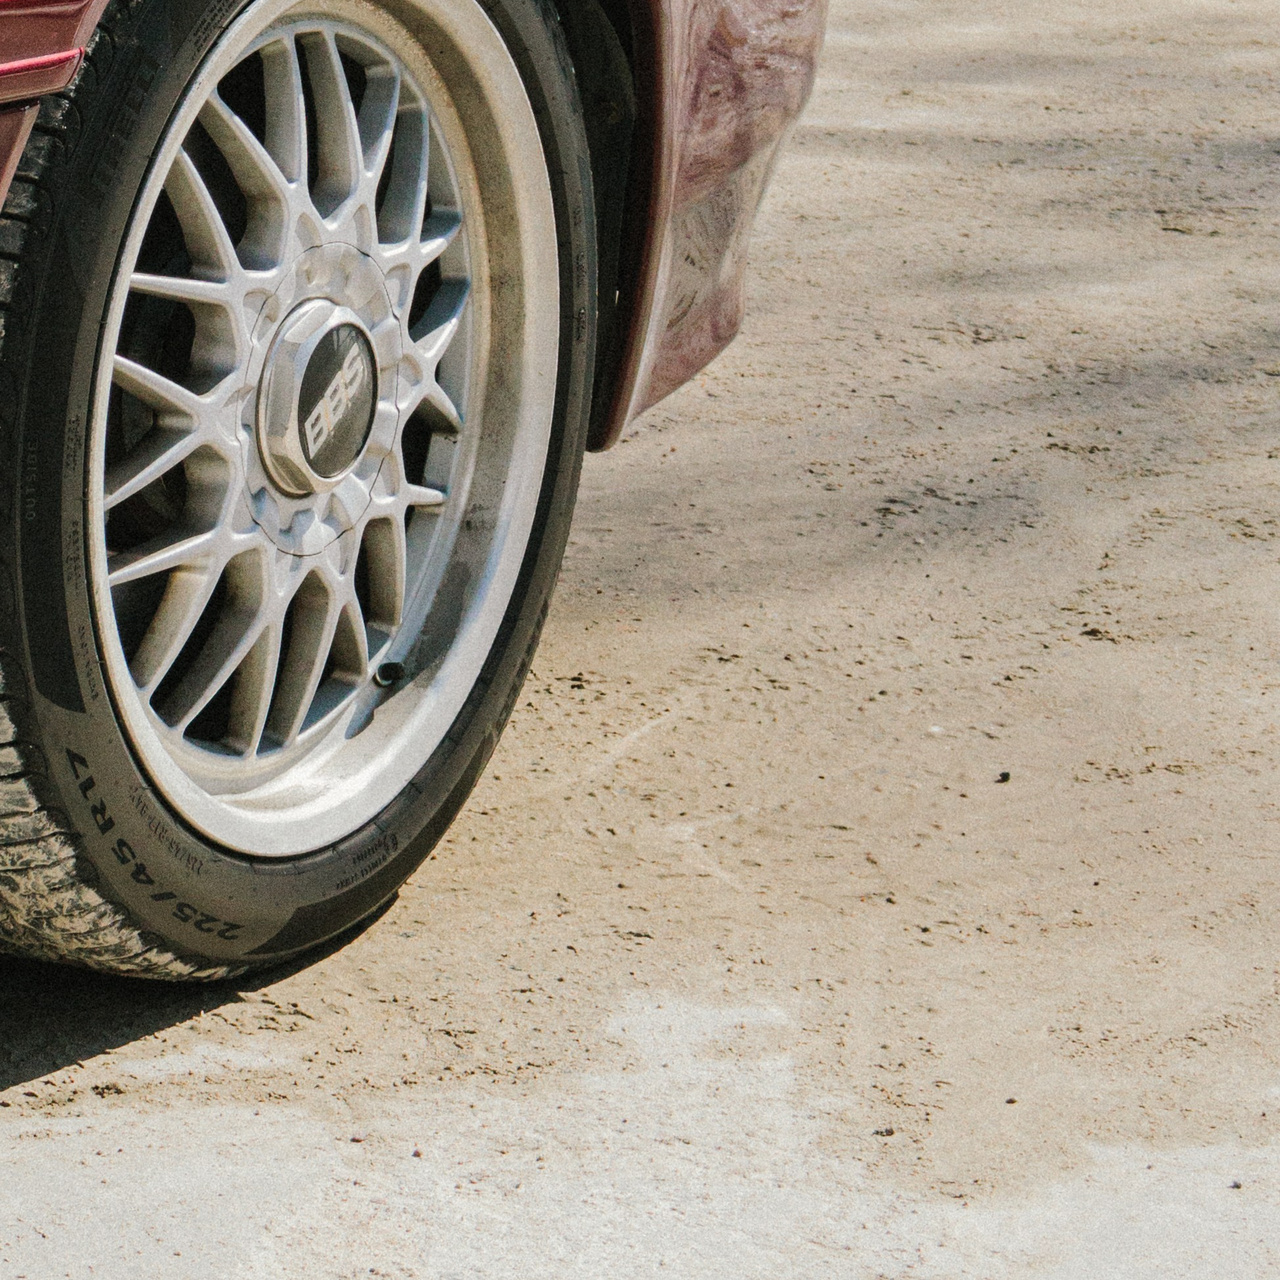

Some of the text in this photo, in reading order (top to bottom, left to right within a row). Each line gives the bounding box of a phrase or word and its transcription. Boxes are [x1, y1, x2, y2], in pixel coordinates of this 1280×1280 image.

[304, 342, 364, 460] BBS
[26, 436, 38, 521] OUTSIDE
[65, 747, 246, 941] 225/45 R17
